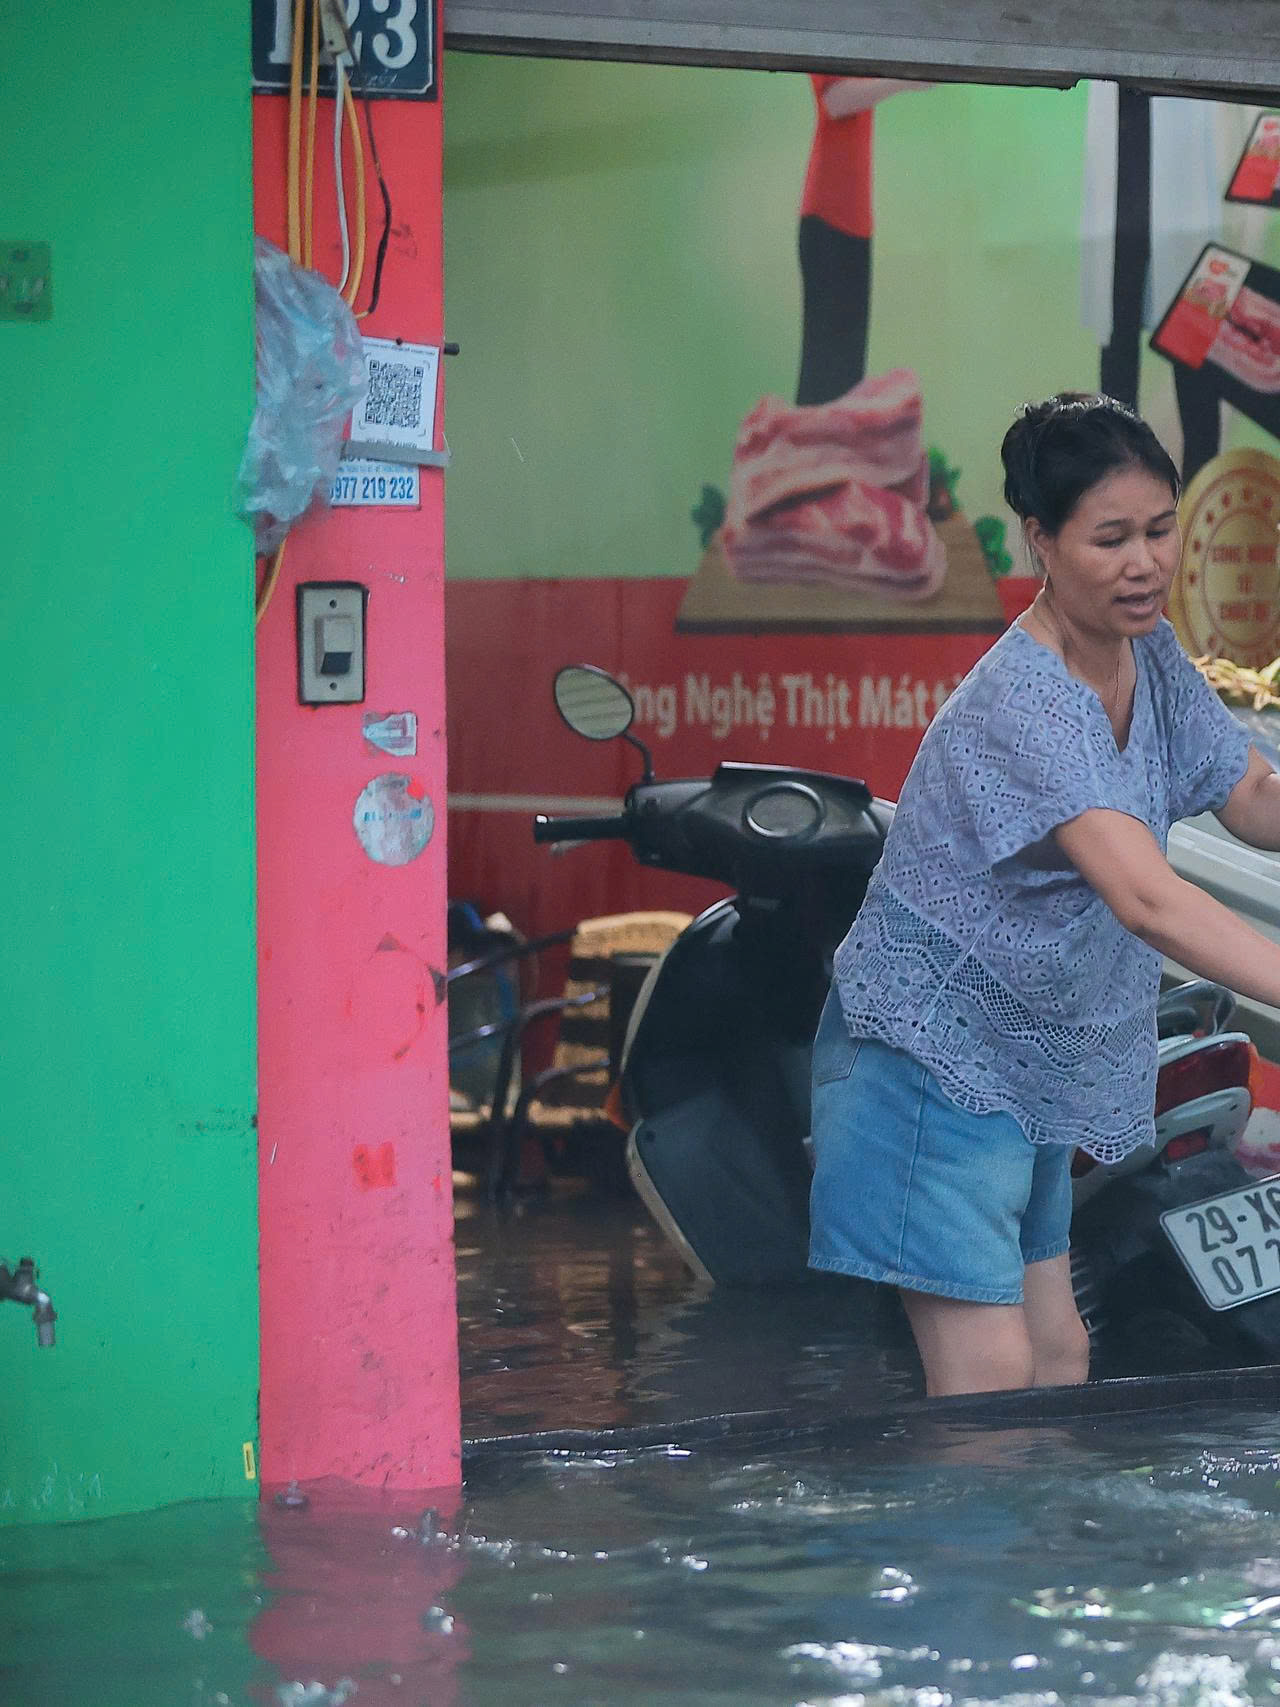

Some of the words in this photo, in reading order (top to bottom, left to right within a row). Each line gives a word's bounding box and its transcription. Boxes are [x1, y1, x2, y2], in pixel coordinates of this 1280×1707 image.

[362, 476, 386, 499] 219
[390, 476, 413, 499] 232
[685, 672, 775, 741] Nghệ
[782, 674, 850, 742] Thịt
